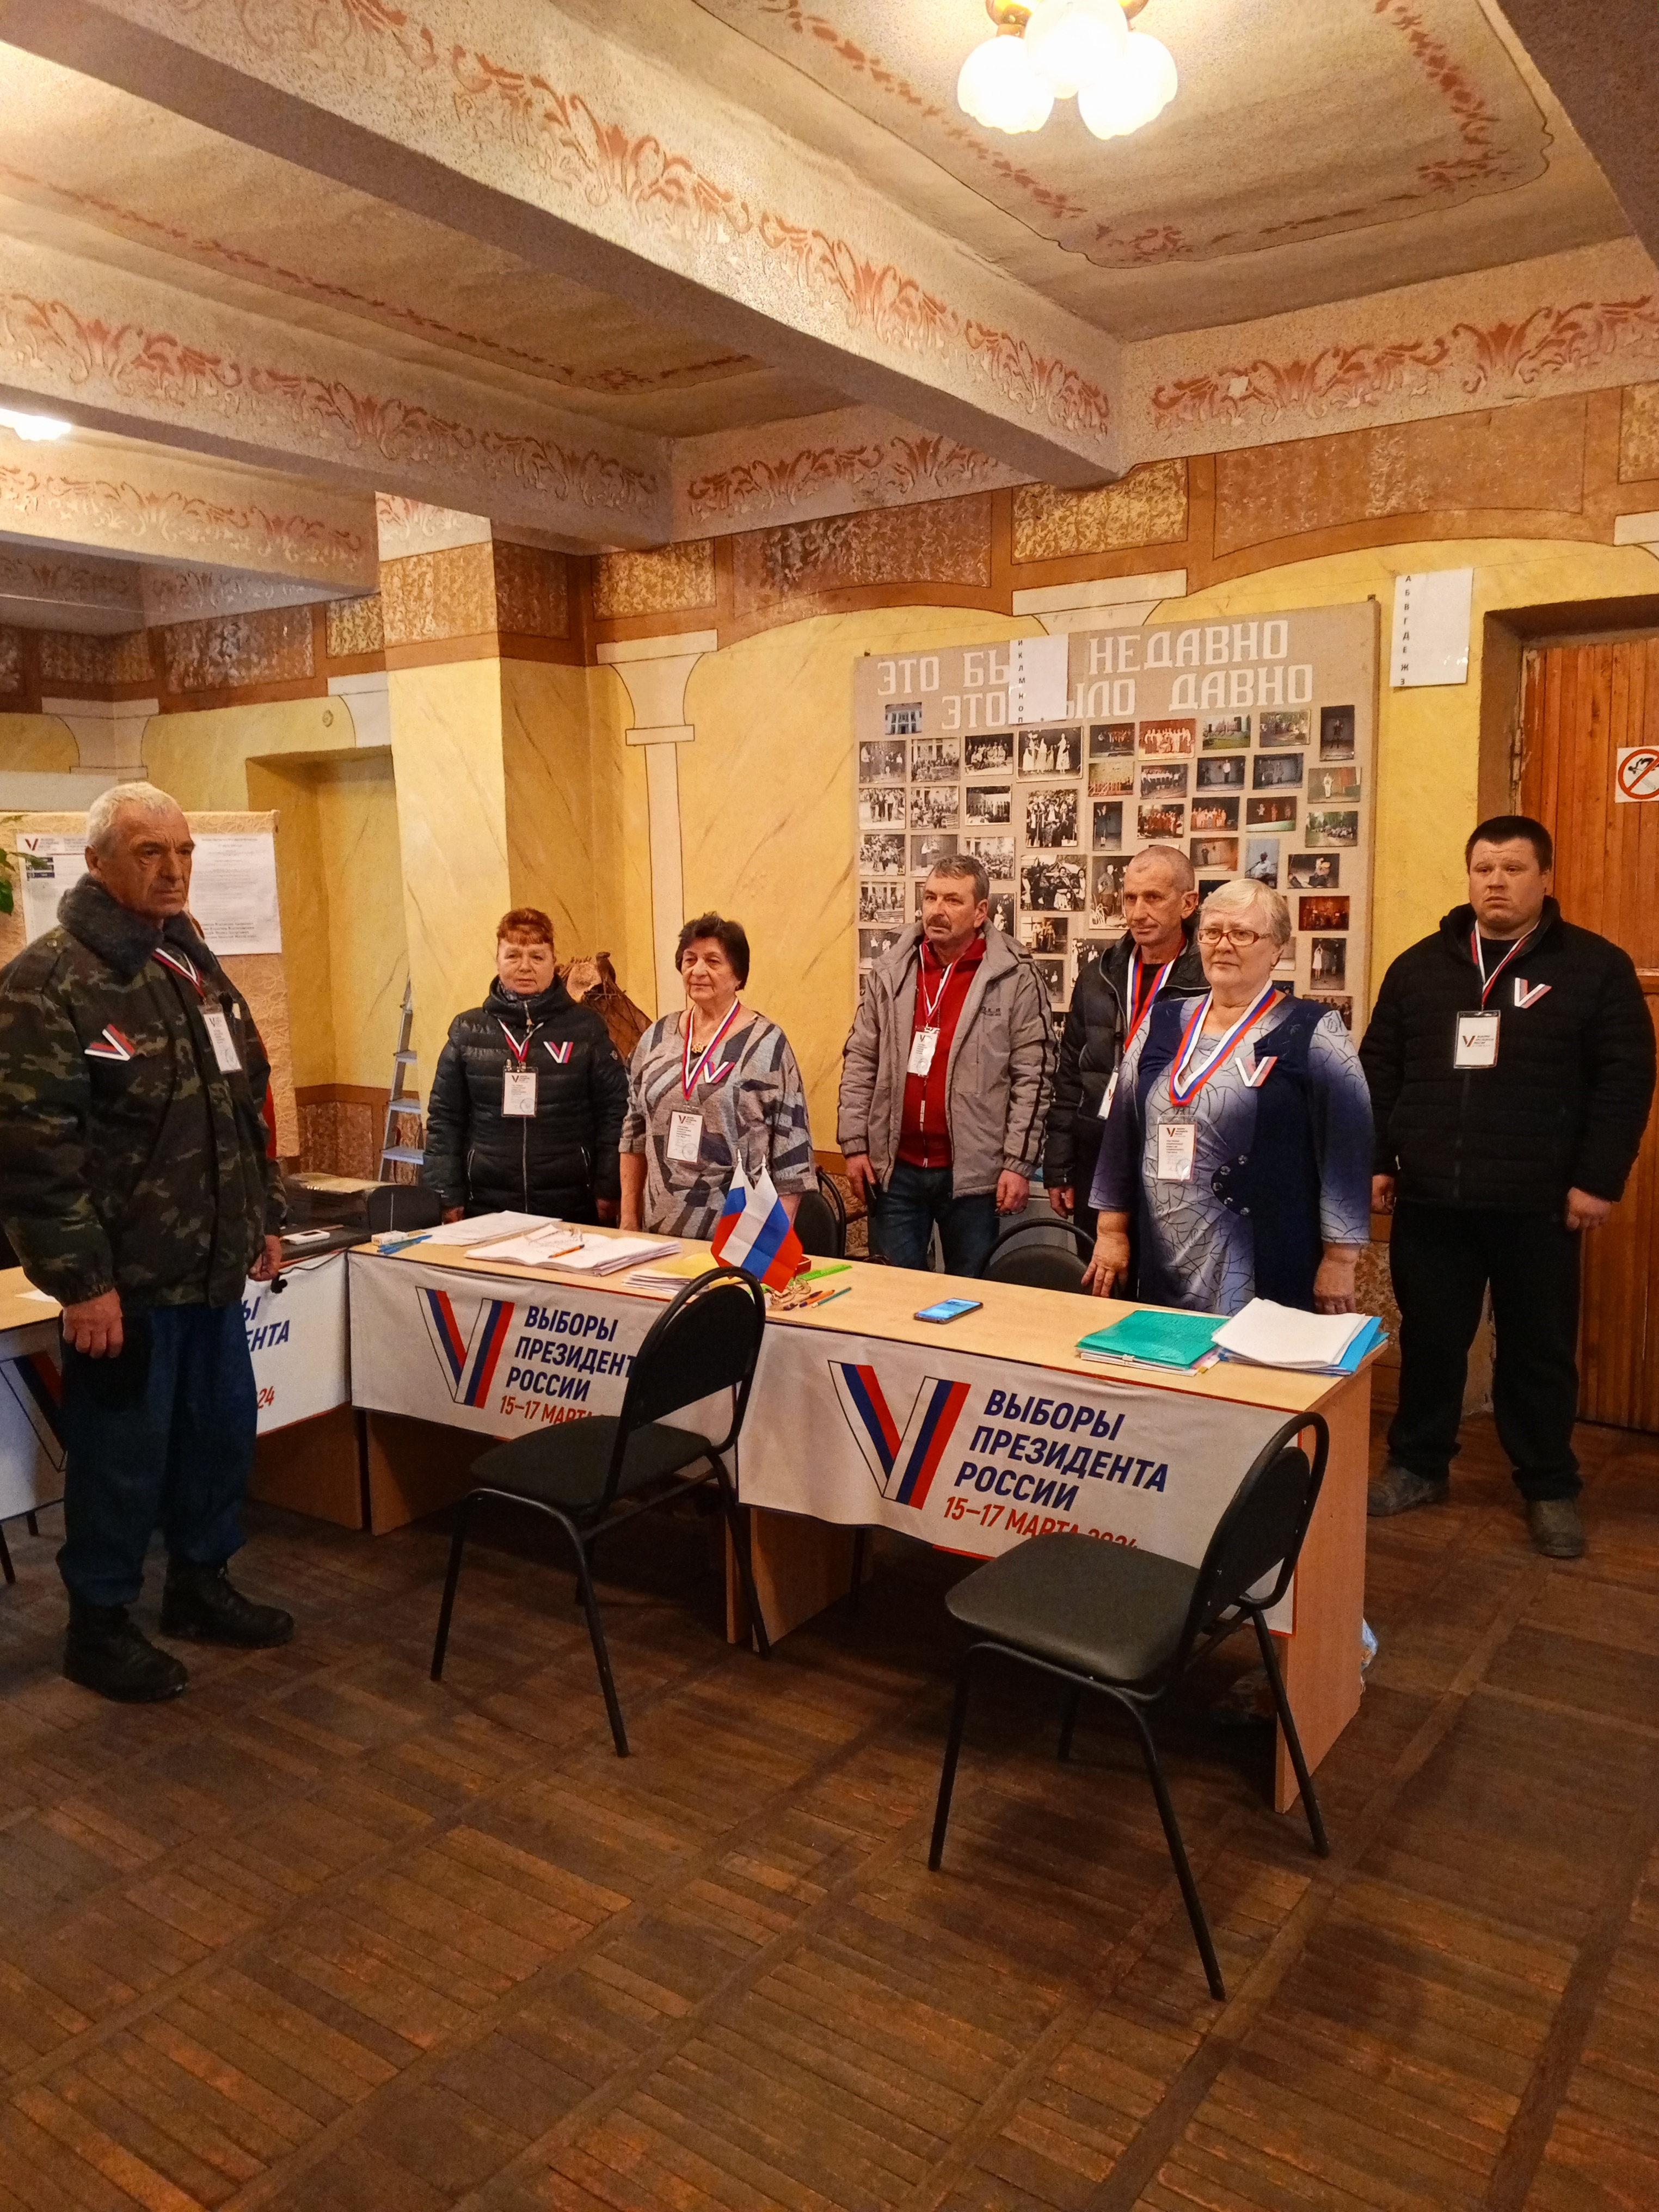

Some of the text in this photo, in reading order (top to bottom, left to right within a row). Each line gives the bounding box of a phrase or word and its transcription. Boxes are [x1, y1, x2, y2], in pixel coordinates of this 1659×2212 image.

[877, 656, 939, 696] ЭТО
[1089, 619, 1288, 675] НЕДАВНО
[941, 691, 1006, 730] ЭТО
[1168, 663, 1313, 711] ДАВНО
[524, 1305, 618, 1342] ВЫБОРЫ
[514, 1336, 638, 1378] ПРЕЗИДЕНТ
[506, 1366, 591, 1402] РОССИИ
[984, 1389, 1126, 1441] ВЫБОРЫ
[969, 1425, 1169, 1492] ПРЕЗИДЕНТА
[954, 1461, 1080, 1511] РОССИИ
